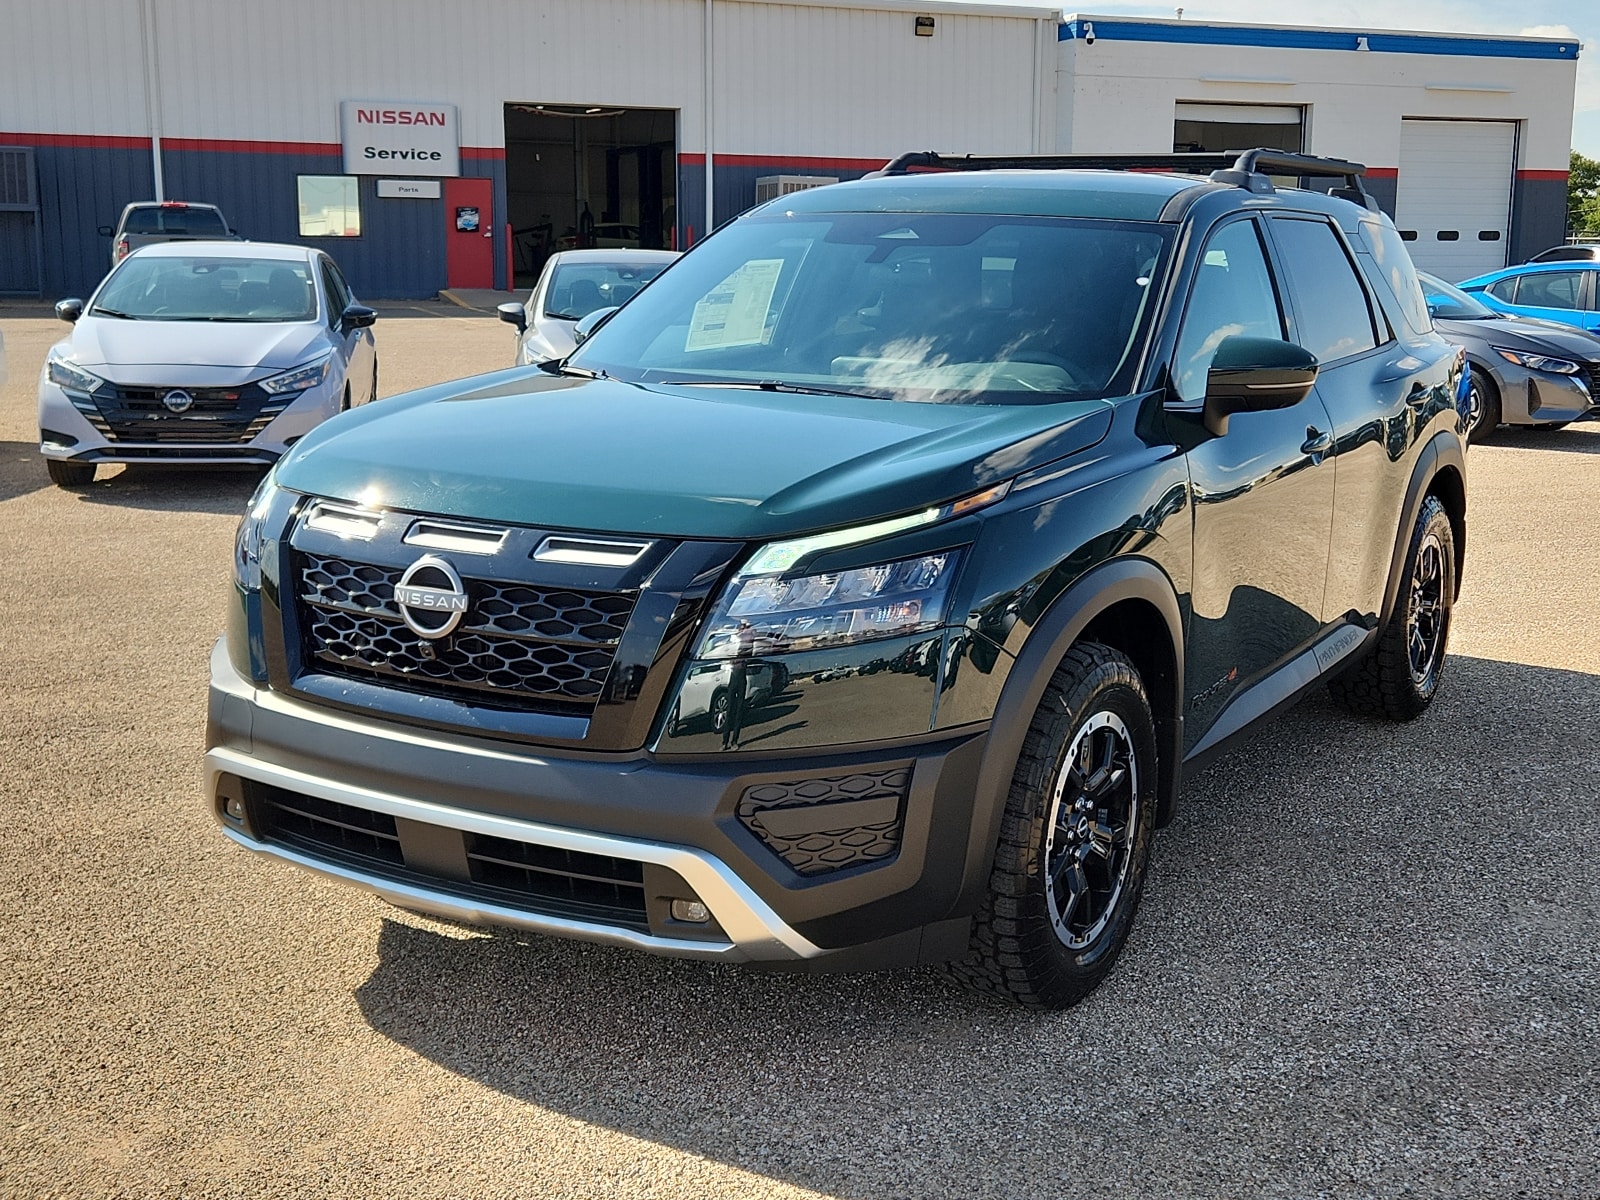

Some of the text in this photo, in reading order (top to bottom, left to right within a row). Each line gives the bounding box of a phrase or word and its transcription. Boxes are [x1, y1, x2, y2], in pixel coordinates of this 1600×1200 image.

[357, 109, 446, 126] NISSAN
[363, 146, 442, 161] Service
[395, 589, 466, 610] NISSAN
